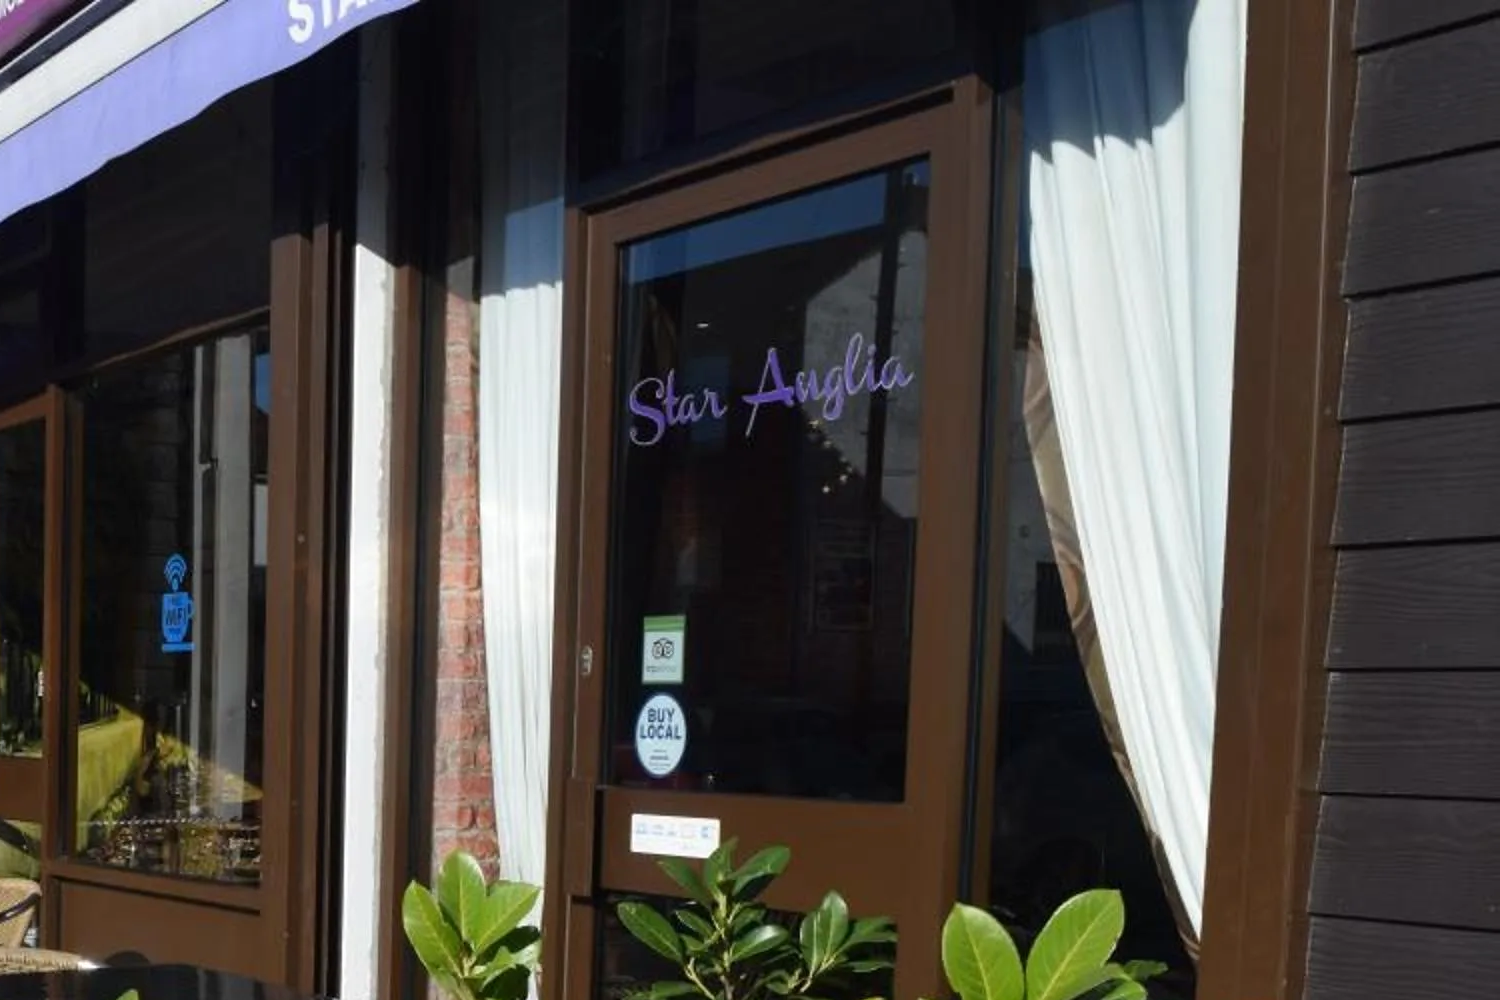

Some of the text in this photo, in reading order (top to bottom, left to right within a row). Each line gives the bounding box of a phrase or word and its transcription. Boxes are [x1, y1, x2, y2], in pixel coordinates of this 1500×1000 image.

[629, 332, 915, 445] Star Anglia
[647, 708, 675, 722] BUY
[639, 724, 682, 740] LOCAL
